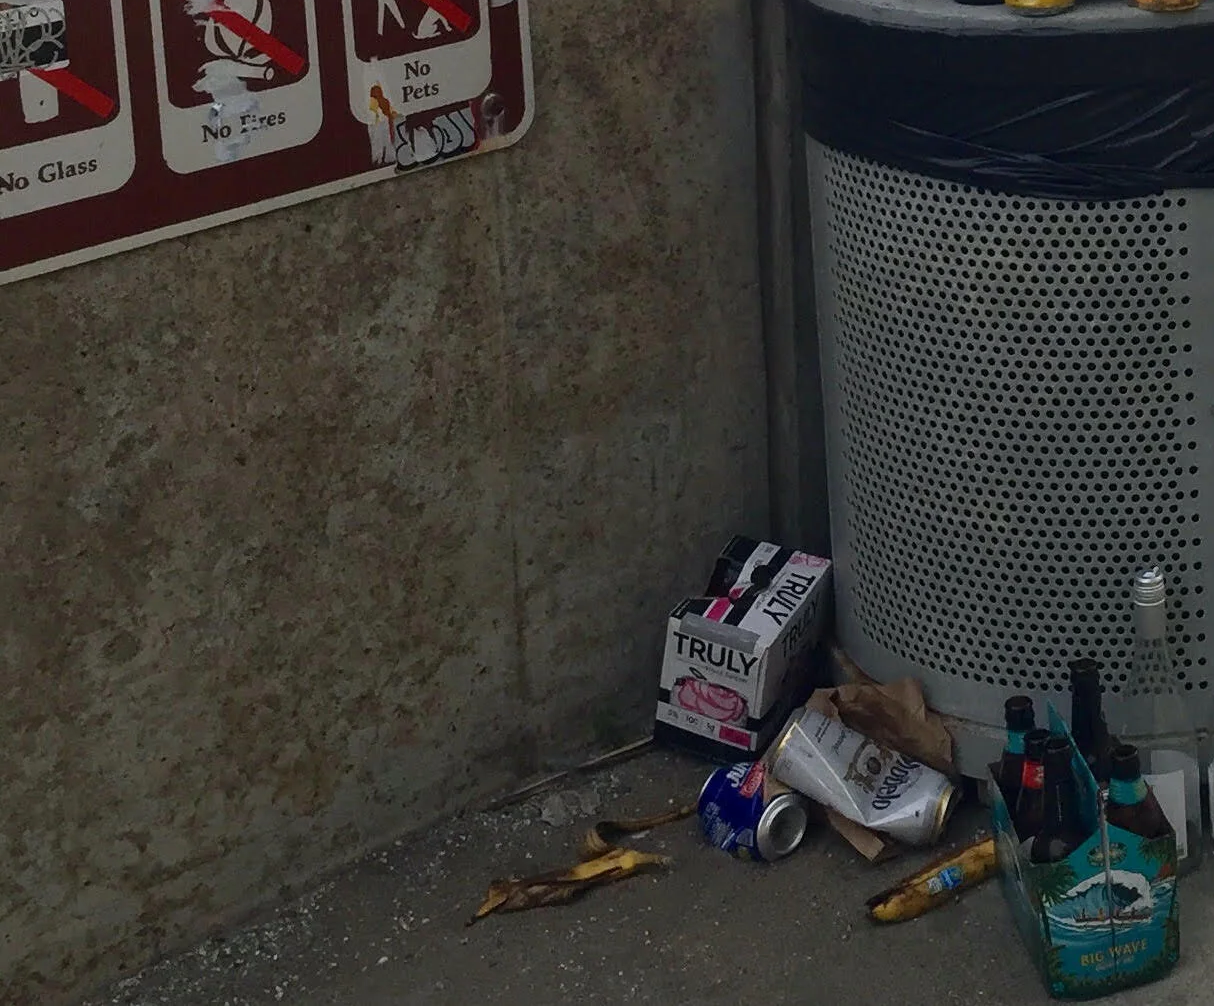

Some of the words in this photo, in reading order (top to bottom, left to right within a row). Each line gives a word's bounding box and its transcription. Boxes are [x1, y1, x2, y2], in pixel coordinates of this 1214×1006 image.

[403, 60, 431, 80] No
[401, 83, 440, 103] Pets
[201, 124, 232, 143] No
[0, 172, 30, 193] No
[37, 158, 98, 184] Glass
[763, 572, 816, 626] TRULY
[673, 631, 759, 676] TRULY
[1080, 950, 1104, 967] BIG
[1108, 938, 1148, 958] WAVE
